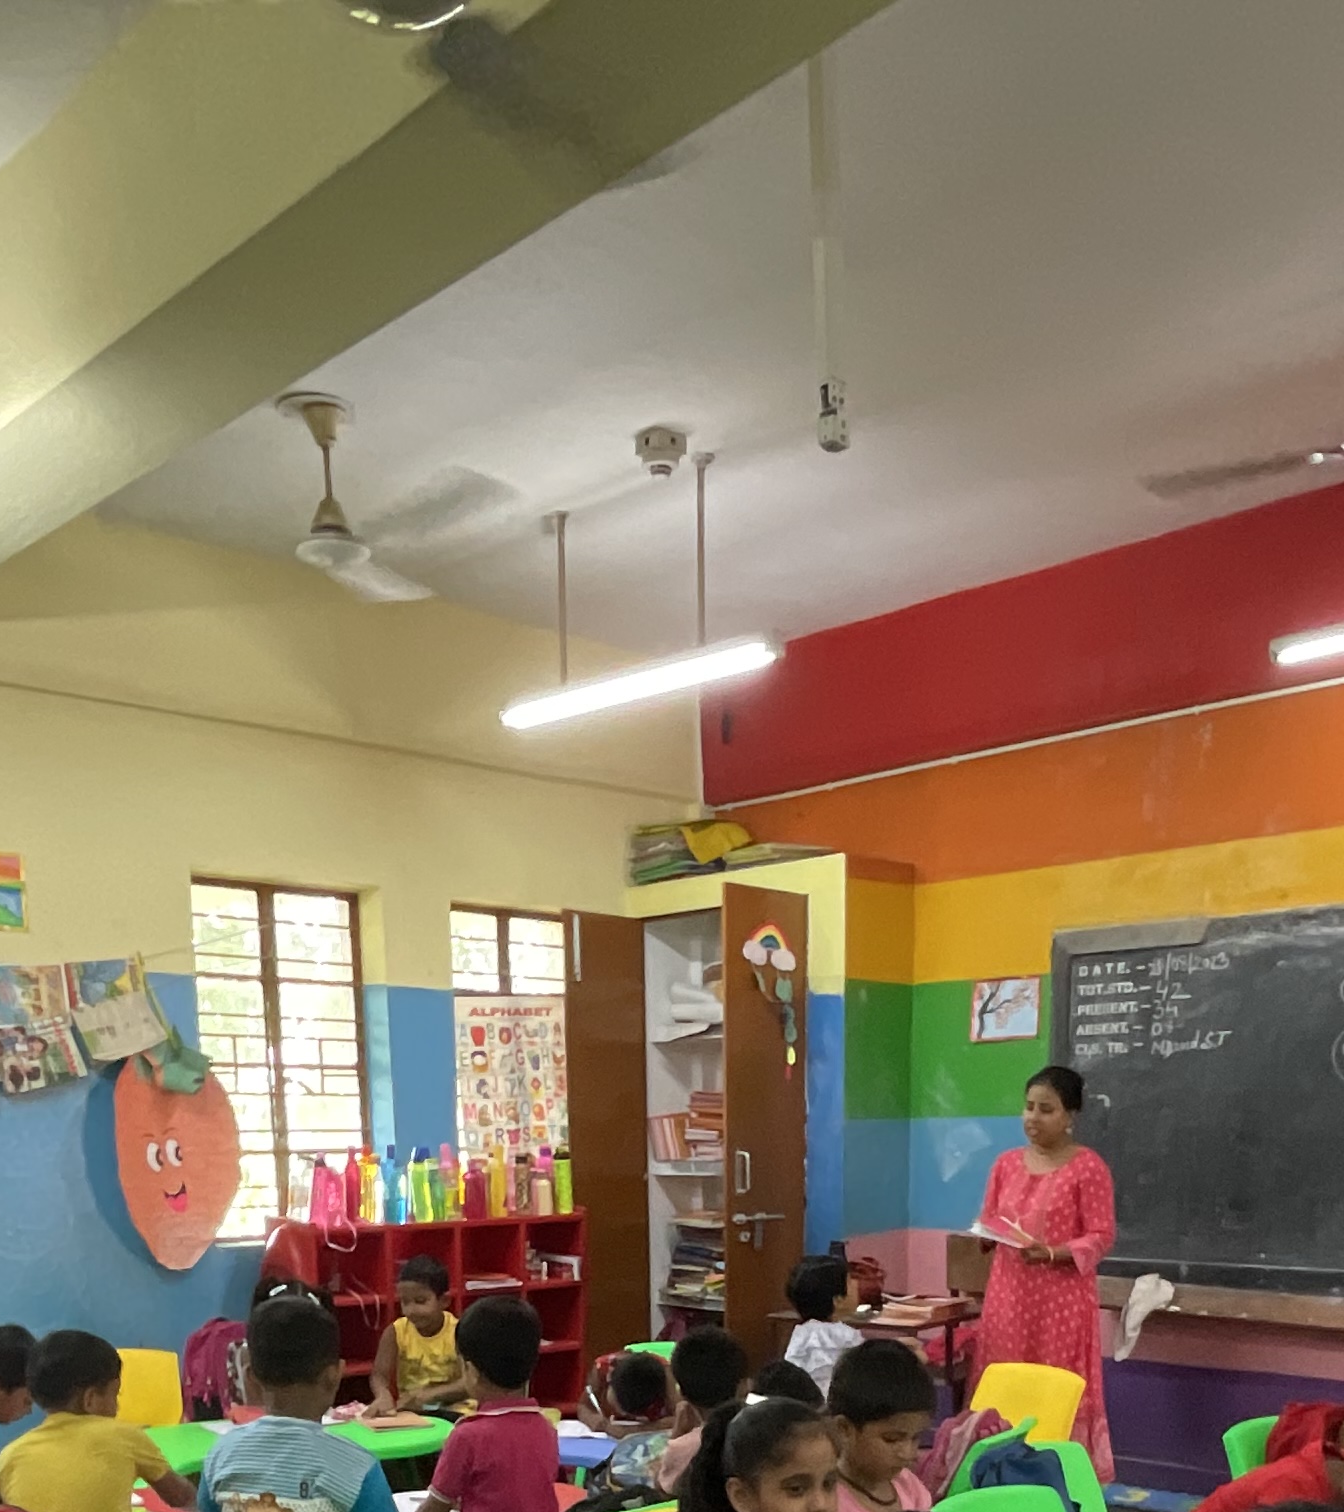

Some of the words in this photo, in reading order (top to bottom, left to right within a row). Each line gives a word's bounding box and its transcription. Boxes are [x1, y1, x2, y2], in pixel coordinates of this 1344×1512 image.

[468, 1007, 554, 1017] ALPHABET
[486, 1023, 495, 1040] B
[513, 1022, 522, 1040] C
[515, 1048, 525, 1066] G
[463, 1103, 476, 1120] M
[493, 1102, 504, 1119] N
[495, 1128, 505, 1144] R
[522, 1126, 531, 1143] S
